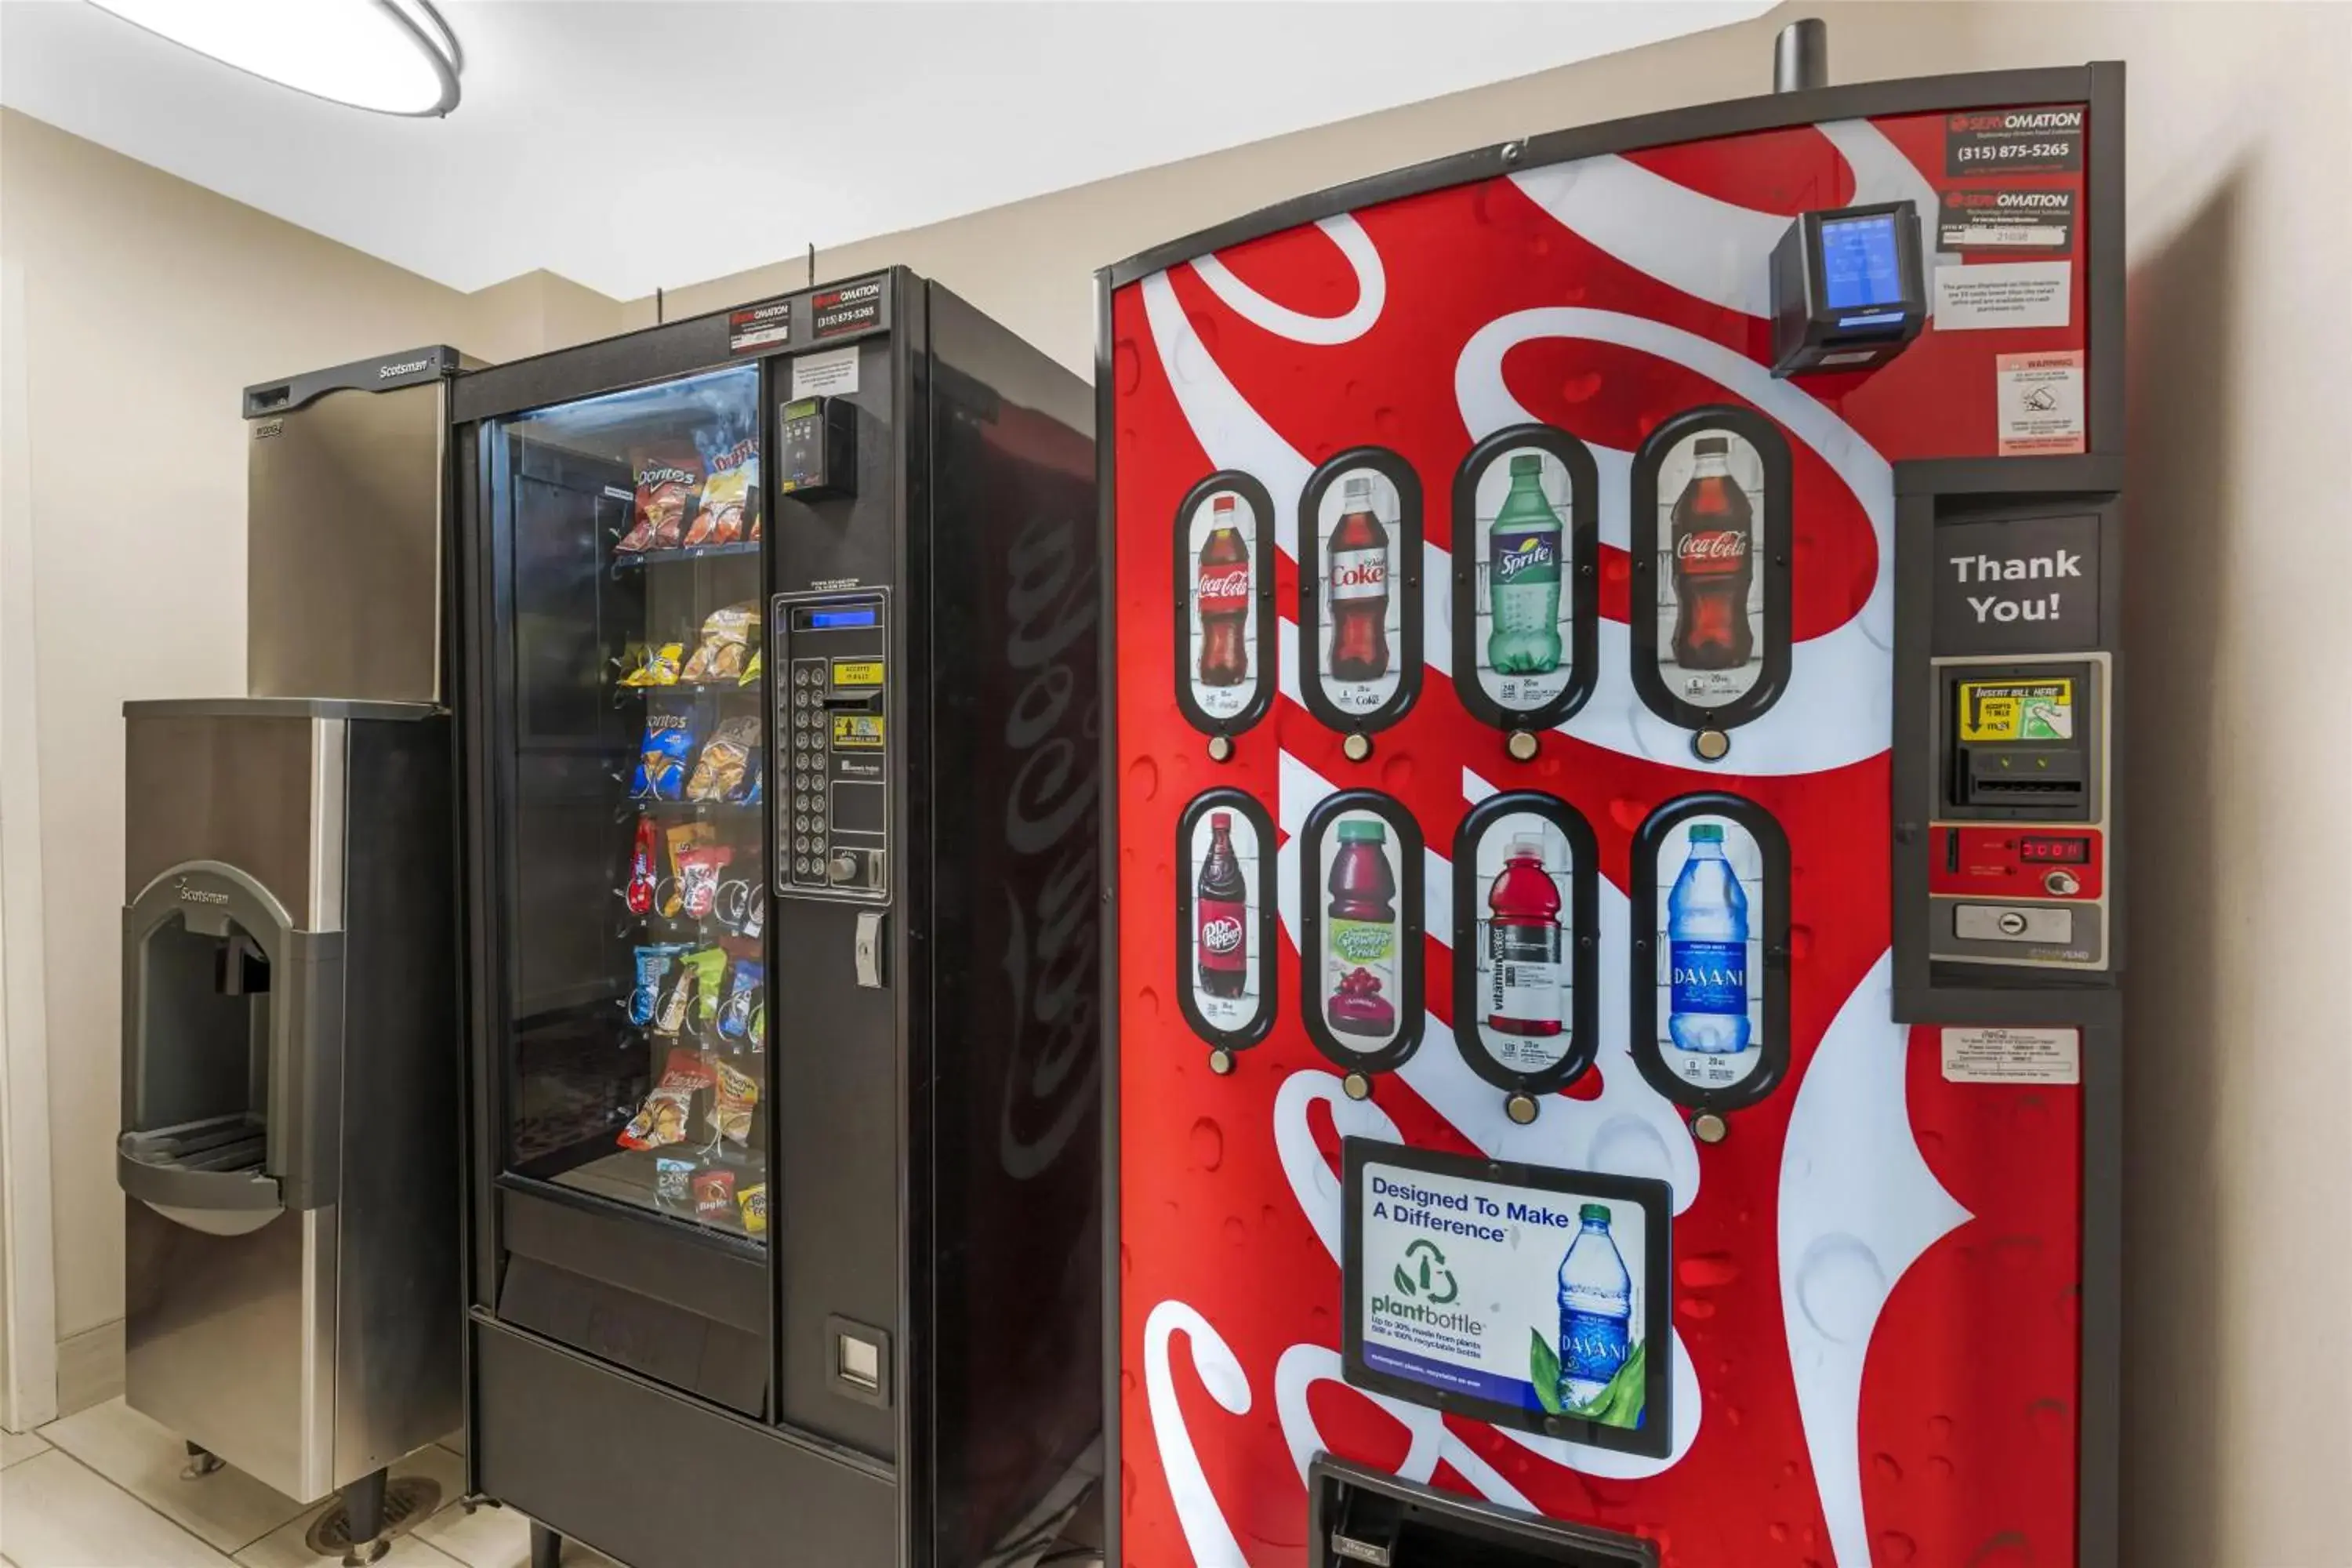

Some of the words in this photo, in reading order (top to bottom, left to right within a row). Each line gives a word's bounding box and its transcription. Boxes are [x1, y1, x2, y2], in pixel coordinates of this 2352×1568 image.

[1958, 147, 1996, 162] (315)
[1999, 143, 2070, 158] 875-5265
[380, 360, 427, 378] Scotsman
[1677, 531, 1746, 559] Coca-Cola
[1501, 545, 1549, 576] Sprite
[1950, 550, 2082, 583] Thank
[1330, 564, 1384, 588] Coke
[1967, 593, 2060, 622] You!
[180, 887, 229, 904] Scotsman
[1492, 927, 1504, 1011] vitaminwater
[1674, 966, 1744, 987] DASANI
[1372, 1177, 1469, 1211] Designed
[1474, 1196, 1501, 1218] To
[1506, 1202, 1569, 1229] Make
[1373, 1201, 1388, 1219] A
[1393, 1205, 1504, 1243] Difference
[1371, 1294, 1482, 1335] plantbottle
[1563, 1334, 1626, 1362] DASANI
